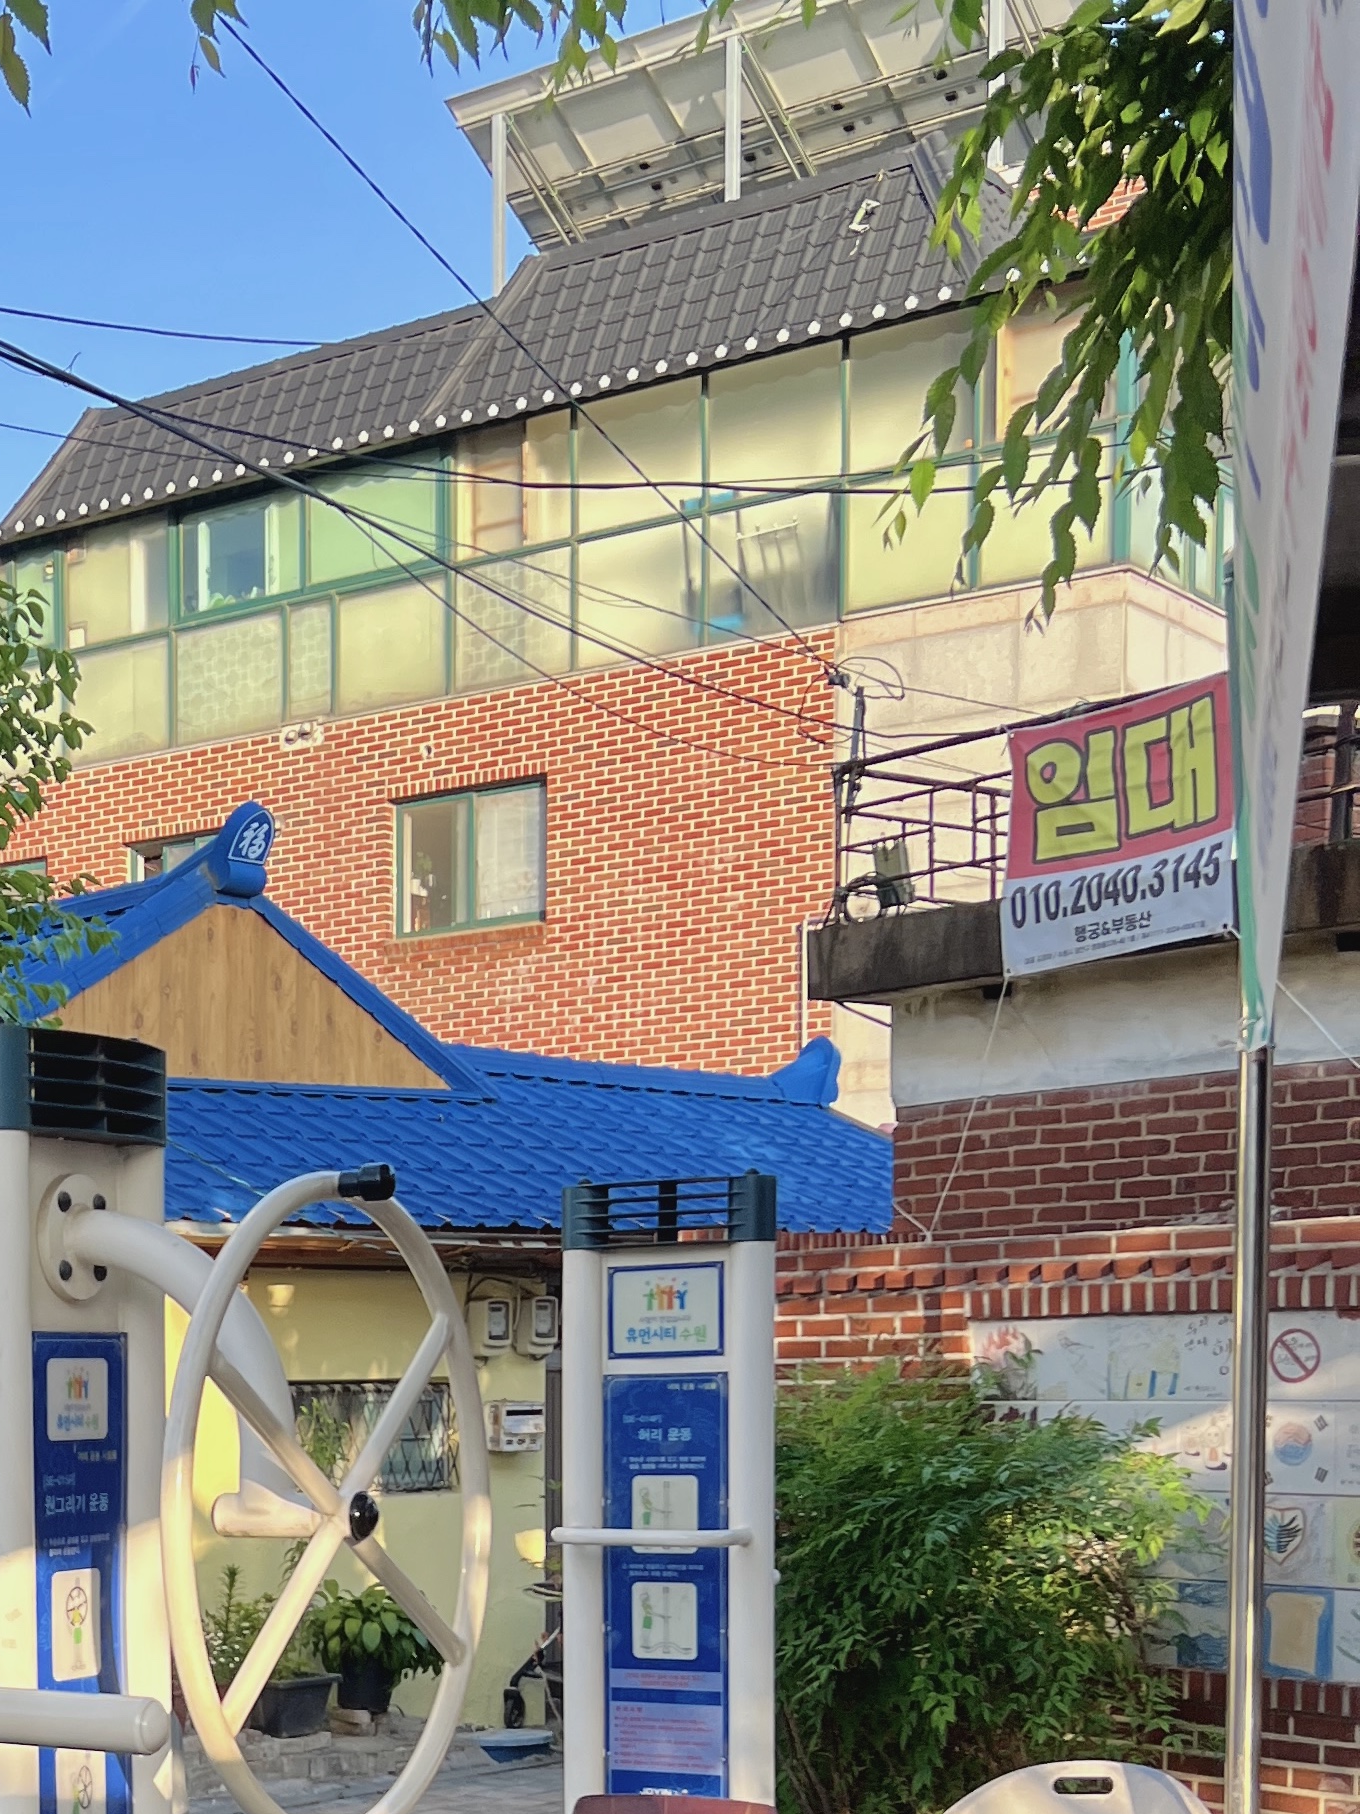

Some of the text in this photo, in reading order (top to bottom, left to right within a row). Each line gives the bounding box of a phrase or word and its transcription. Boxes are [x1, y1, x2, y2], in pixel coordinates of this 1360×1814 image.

[1026, 691, 1218, 864] 임대
[239, 822, 269, 859] 福
[1010, 842, 1223, 929] 010.2040.3145
[626, 1325, 707, 1344] 휴먼시티 수원
